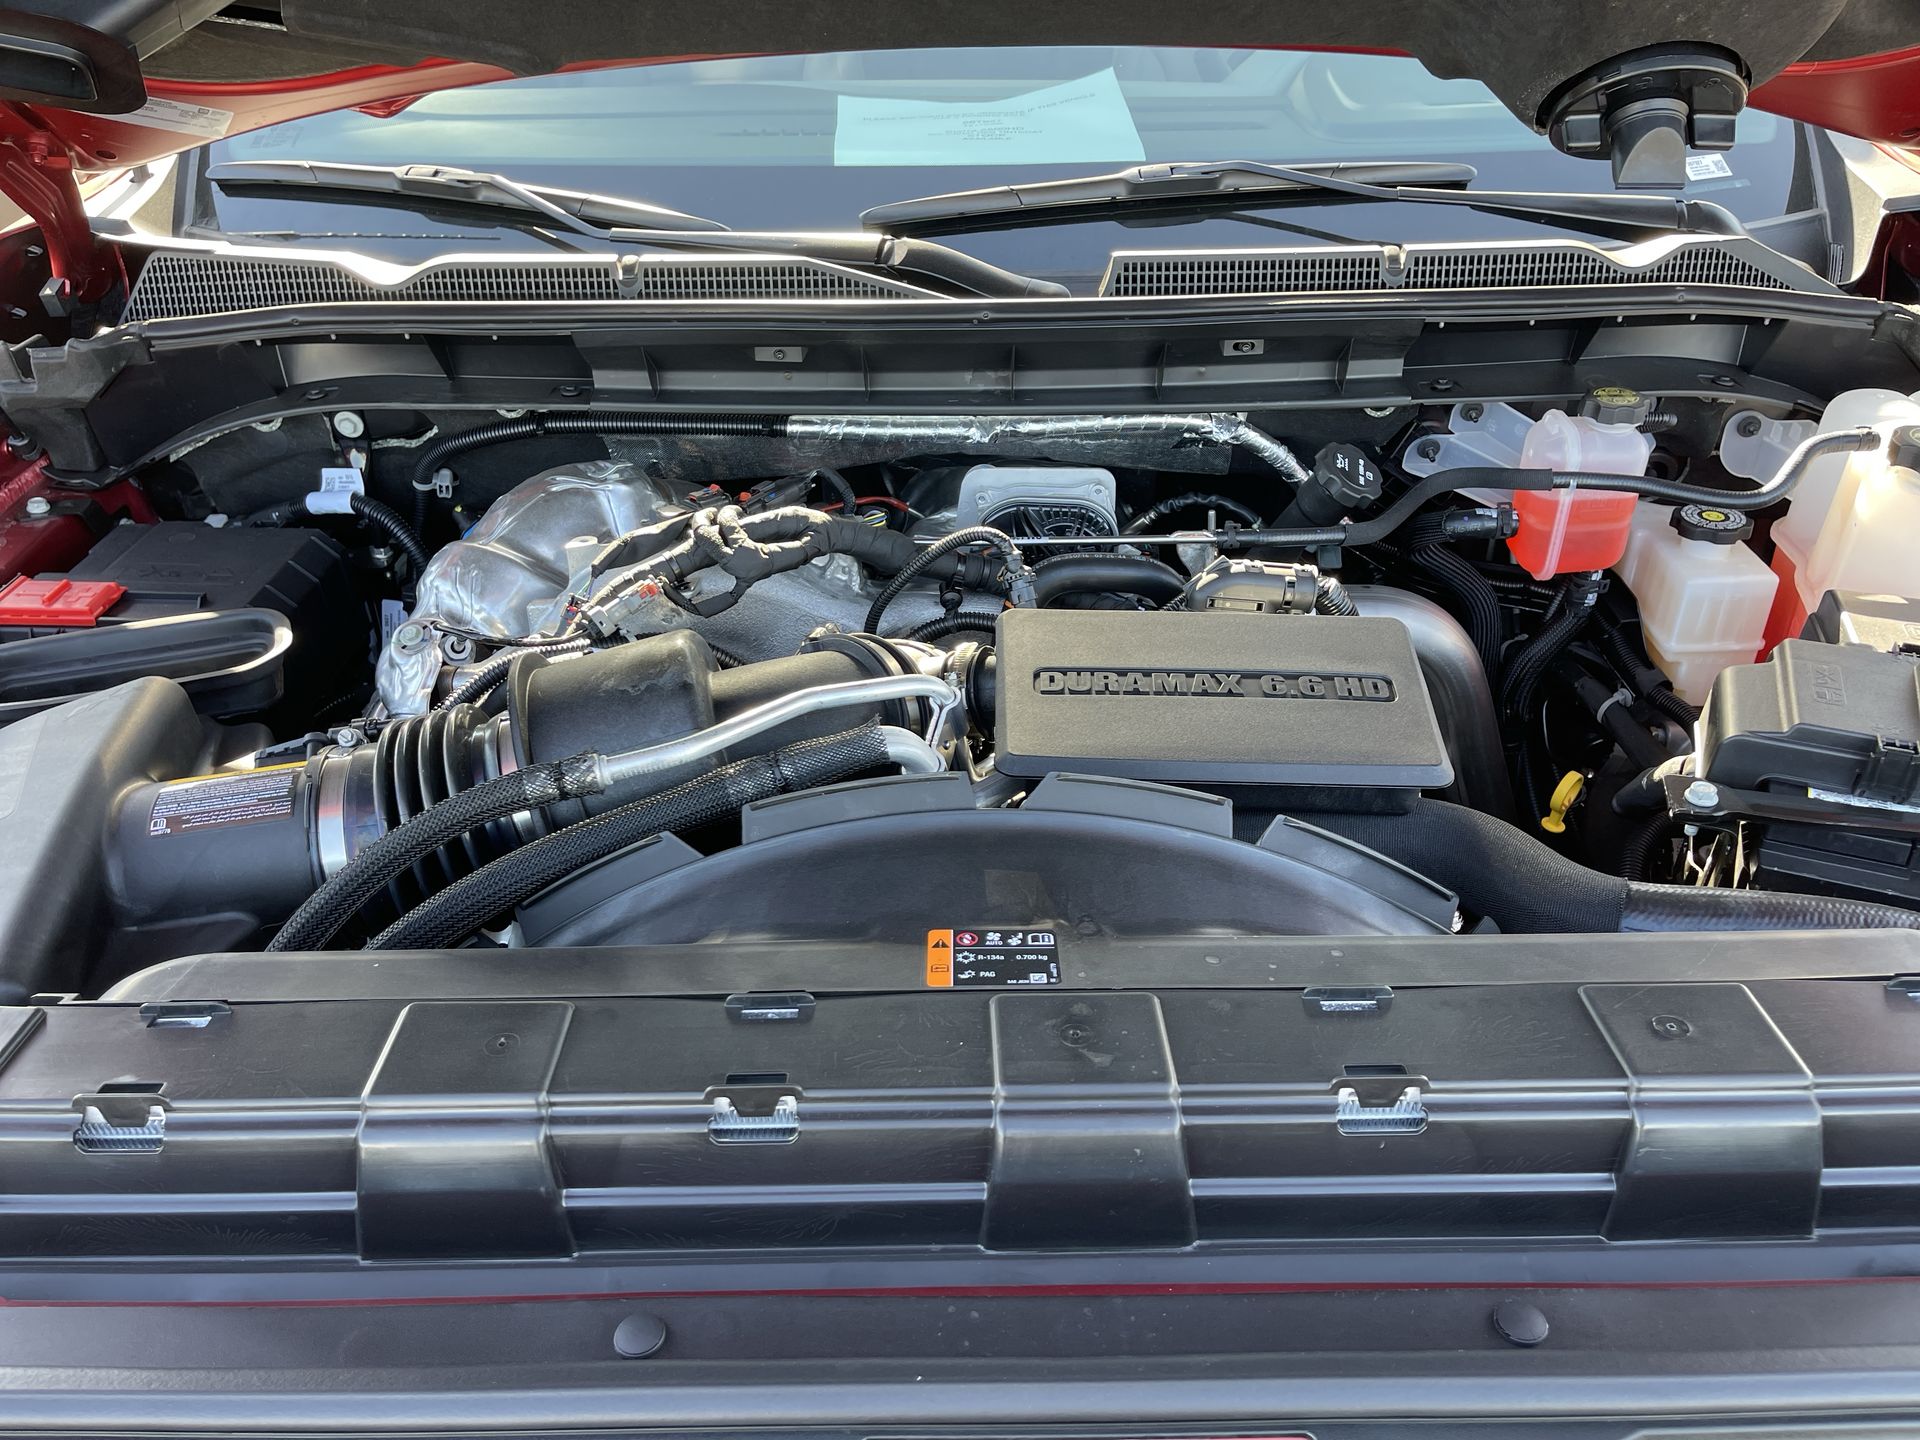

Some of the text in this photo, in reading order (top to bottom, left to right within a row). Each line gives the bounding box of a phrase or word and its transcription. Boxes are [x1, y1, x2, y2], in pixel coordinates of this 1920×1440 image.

[1039, 671, 1391, 698] DURAMAX 6.6 HD
